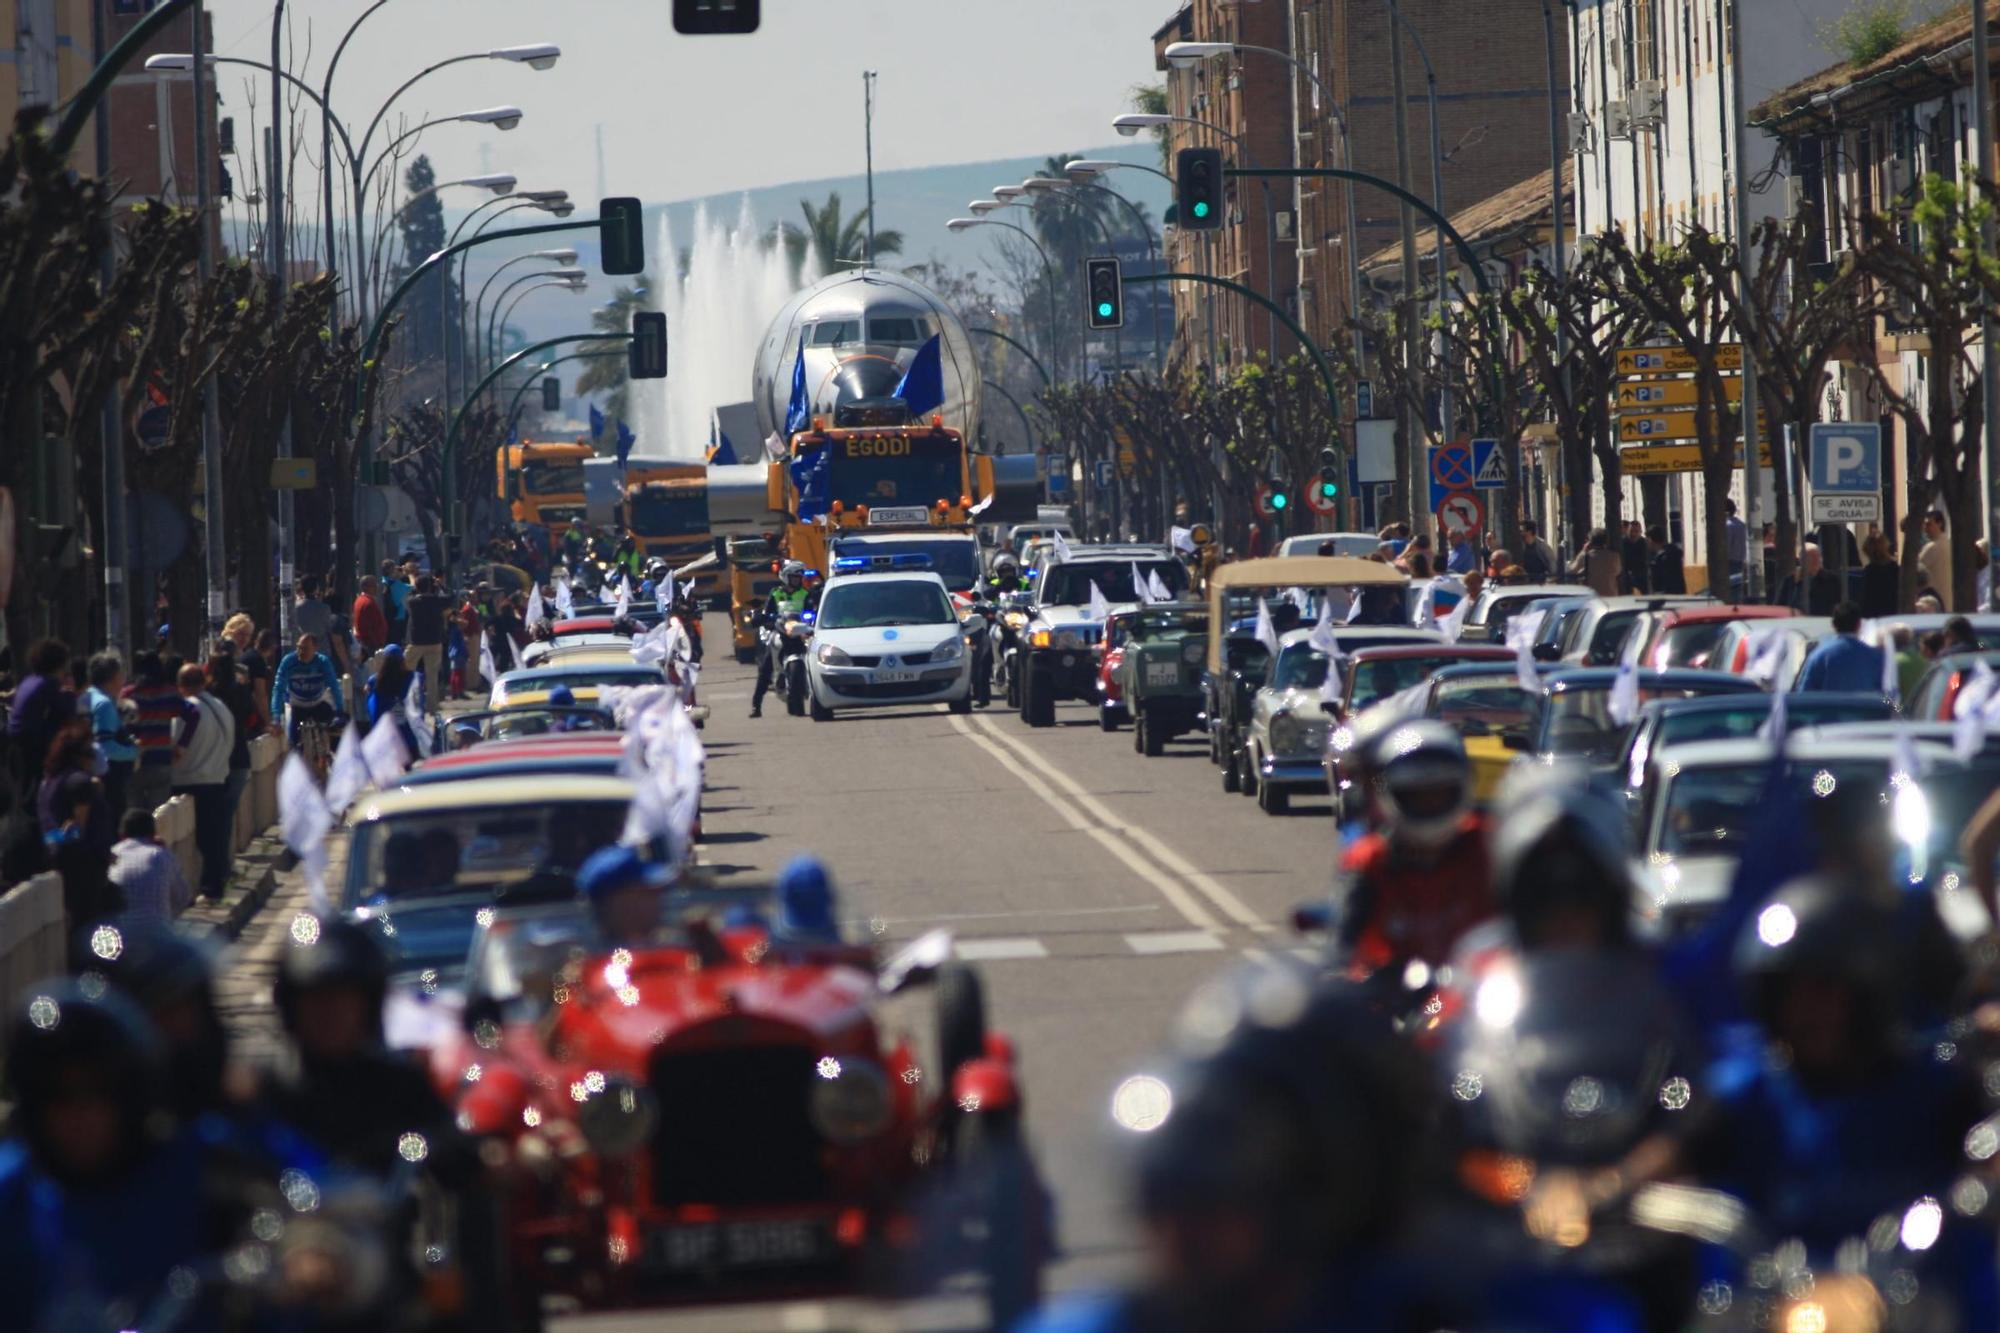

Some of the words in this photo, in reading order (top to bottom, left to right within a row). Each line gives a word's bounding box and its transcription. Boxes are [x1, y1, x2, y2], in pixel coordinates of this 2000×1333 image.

[846, 438, 911, 456] EGODI
[1827, 436, 1864, 485] P
[1817, 499, 1832, 509] SE
[1839, 498, 1874, 508] AVISA
